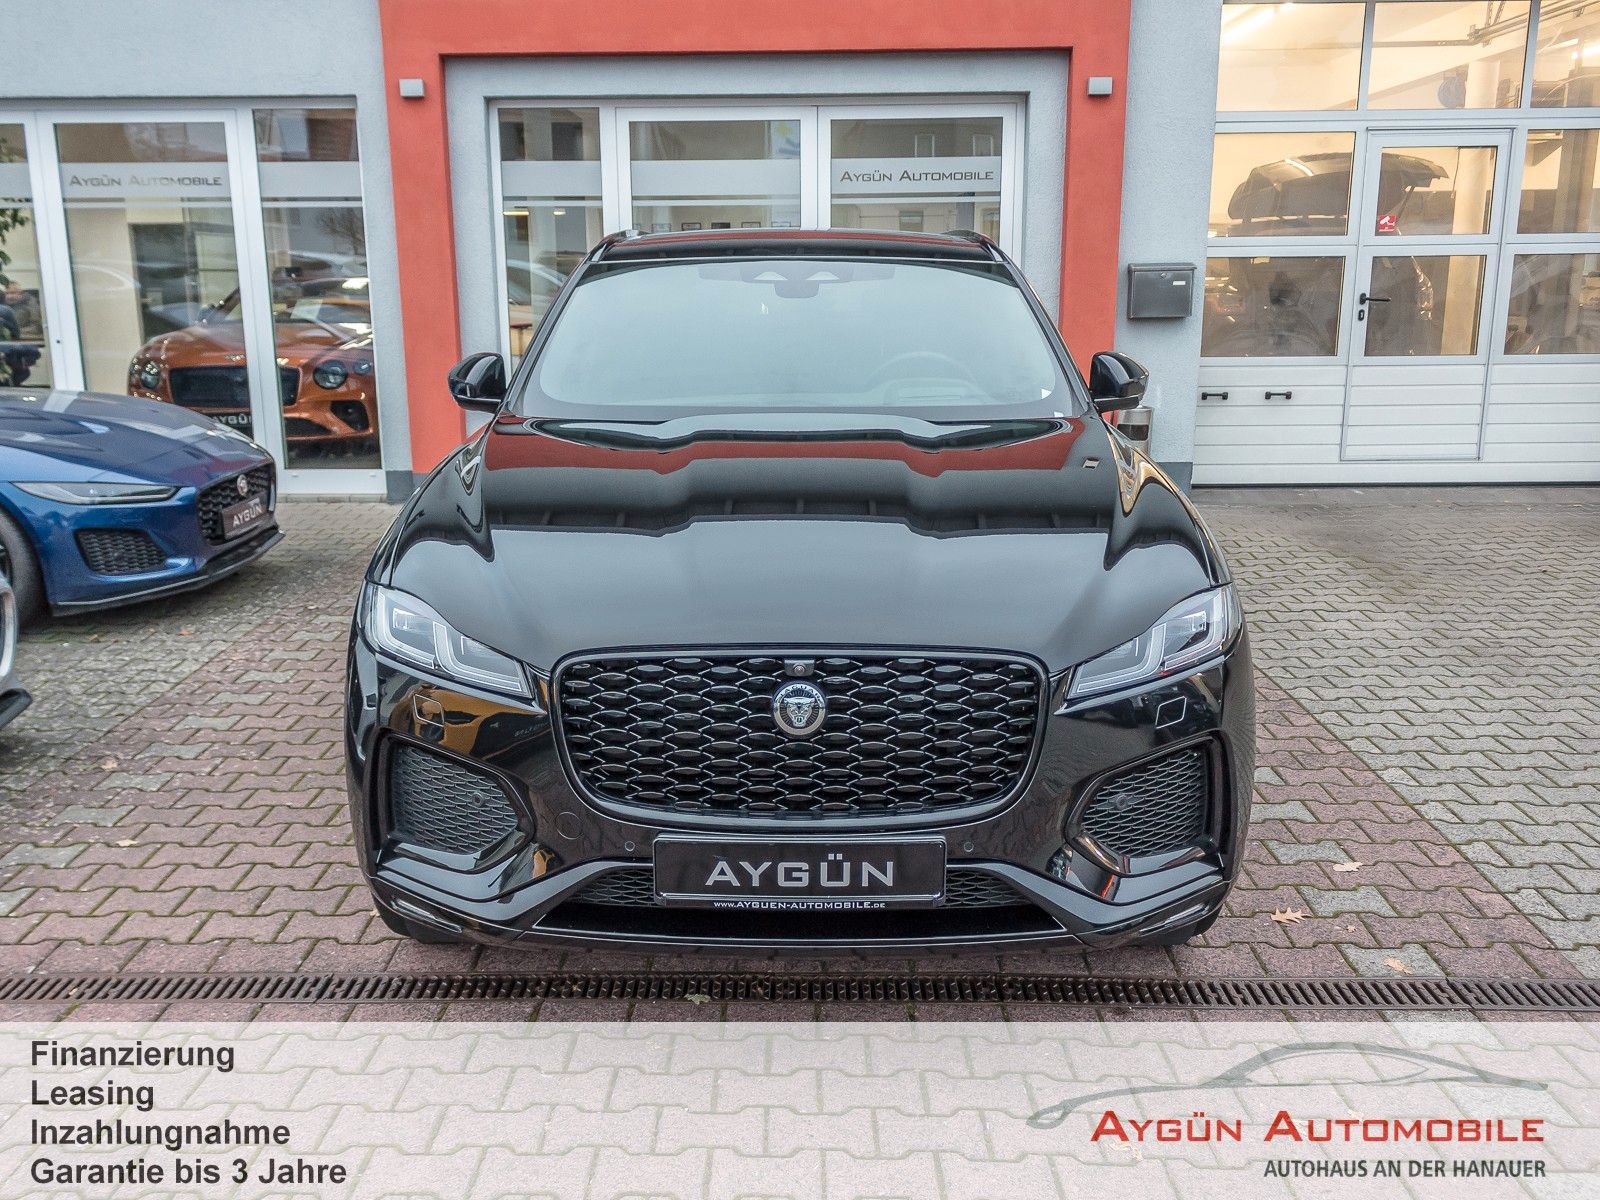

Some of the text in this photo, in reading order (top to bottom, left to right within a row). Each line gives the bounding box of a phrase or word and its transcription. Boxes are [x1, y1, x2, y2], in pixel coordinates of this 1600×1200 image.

[69, 174, 222, 187] AYGÜN AUTOMOBILE
[840, 170, 994, 182] AYGÜN AUTOMOBILE
[705, 853, 894, 887] AYGÜN
